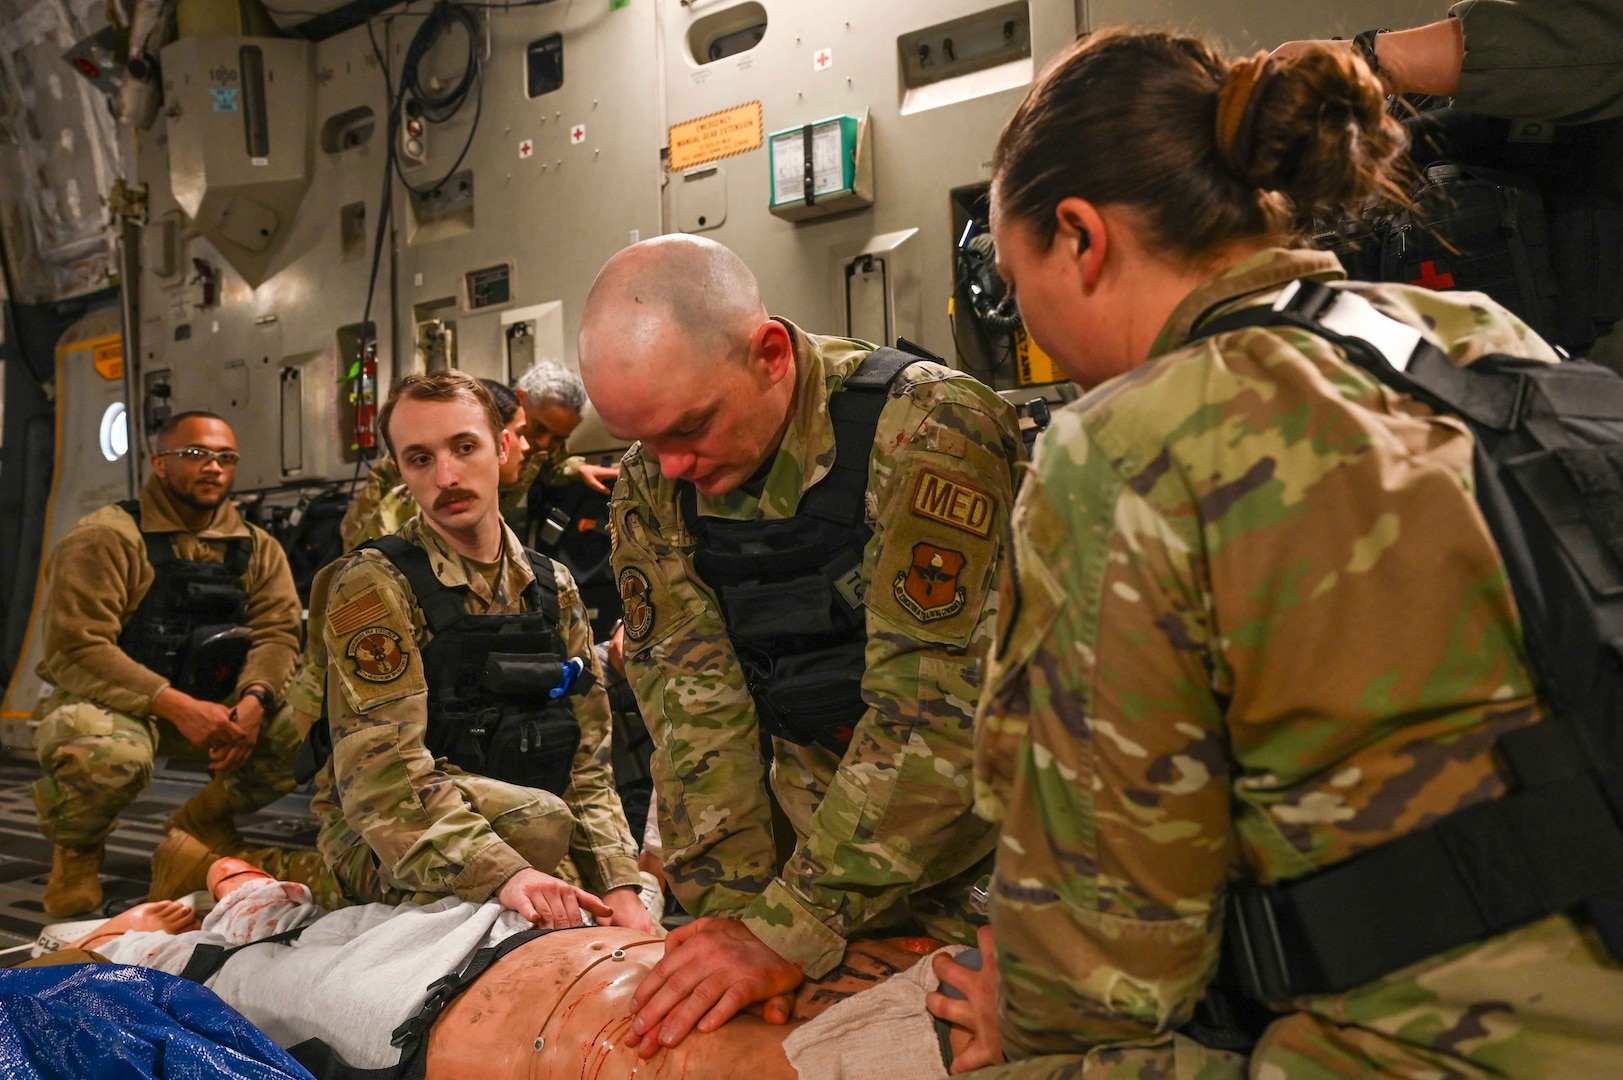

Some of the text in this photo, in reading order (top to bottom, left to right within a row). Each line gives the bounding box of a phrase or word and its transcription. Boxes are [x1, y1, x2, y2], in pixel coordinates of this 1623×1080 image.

[677, 120, 753, 147] MANUAL GEAR EXTENSION
[695, 116, 731, 132] EMERGENCY
[920, 476, 989, 528] MED
[38, 936, 60, 952] CL2
